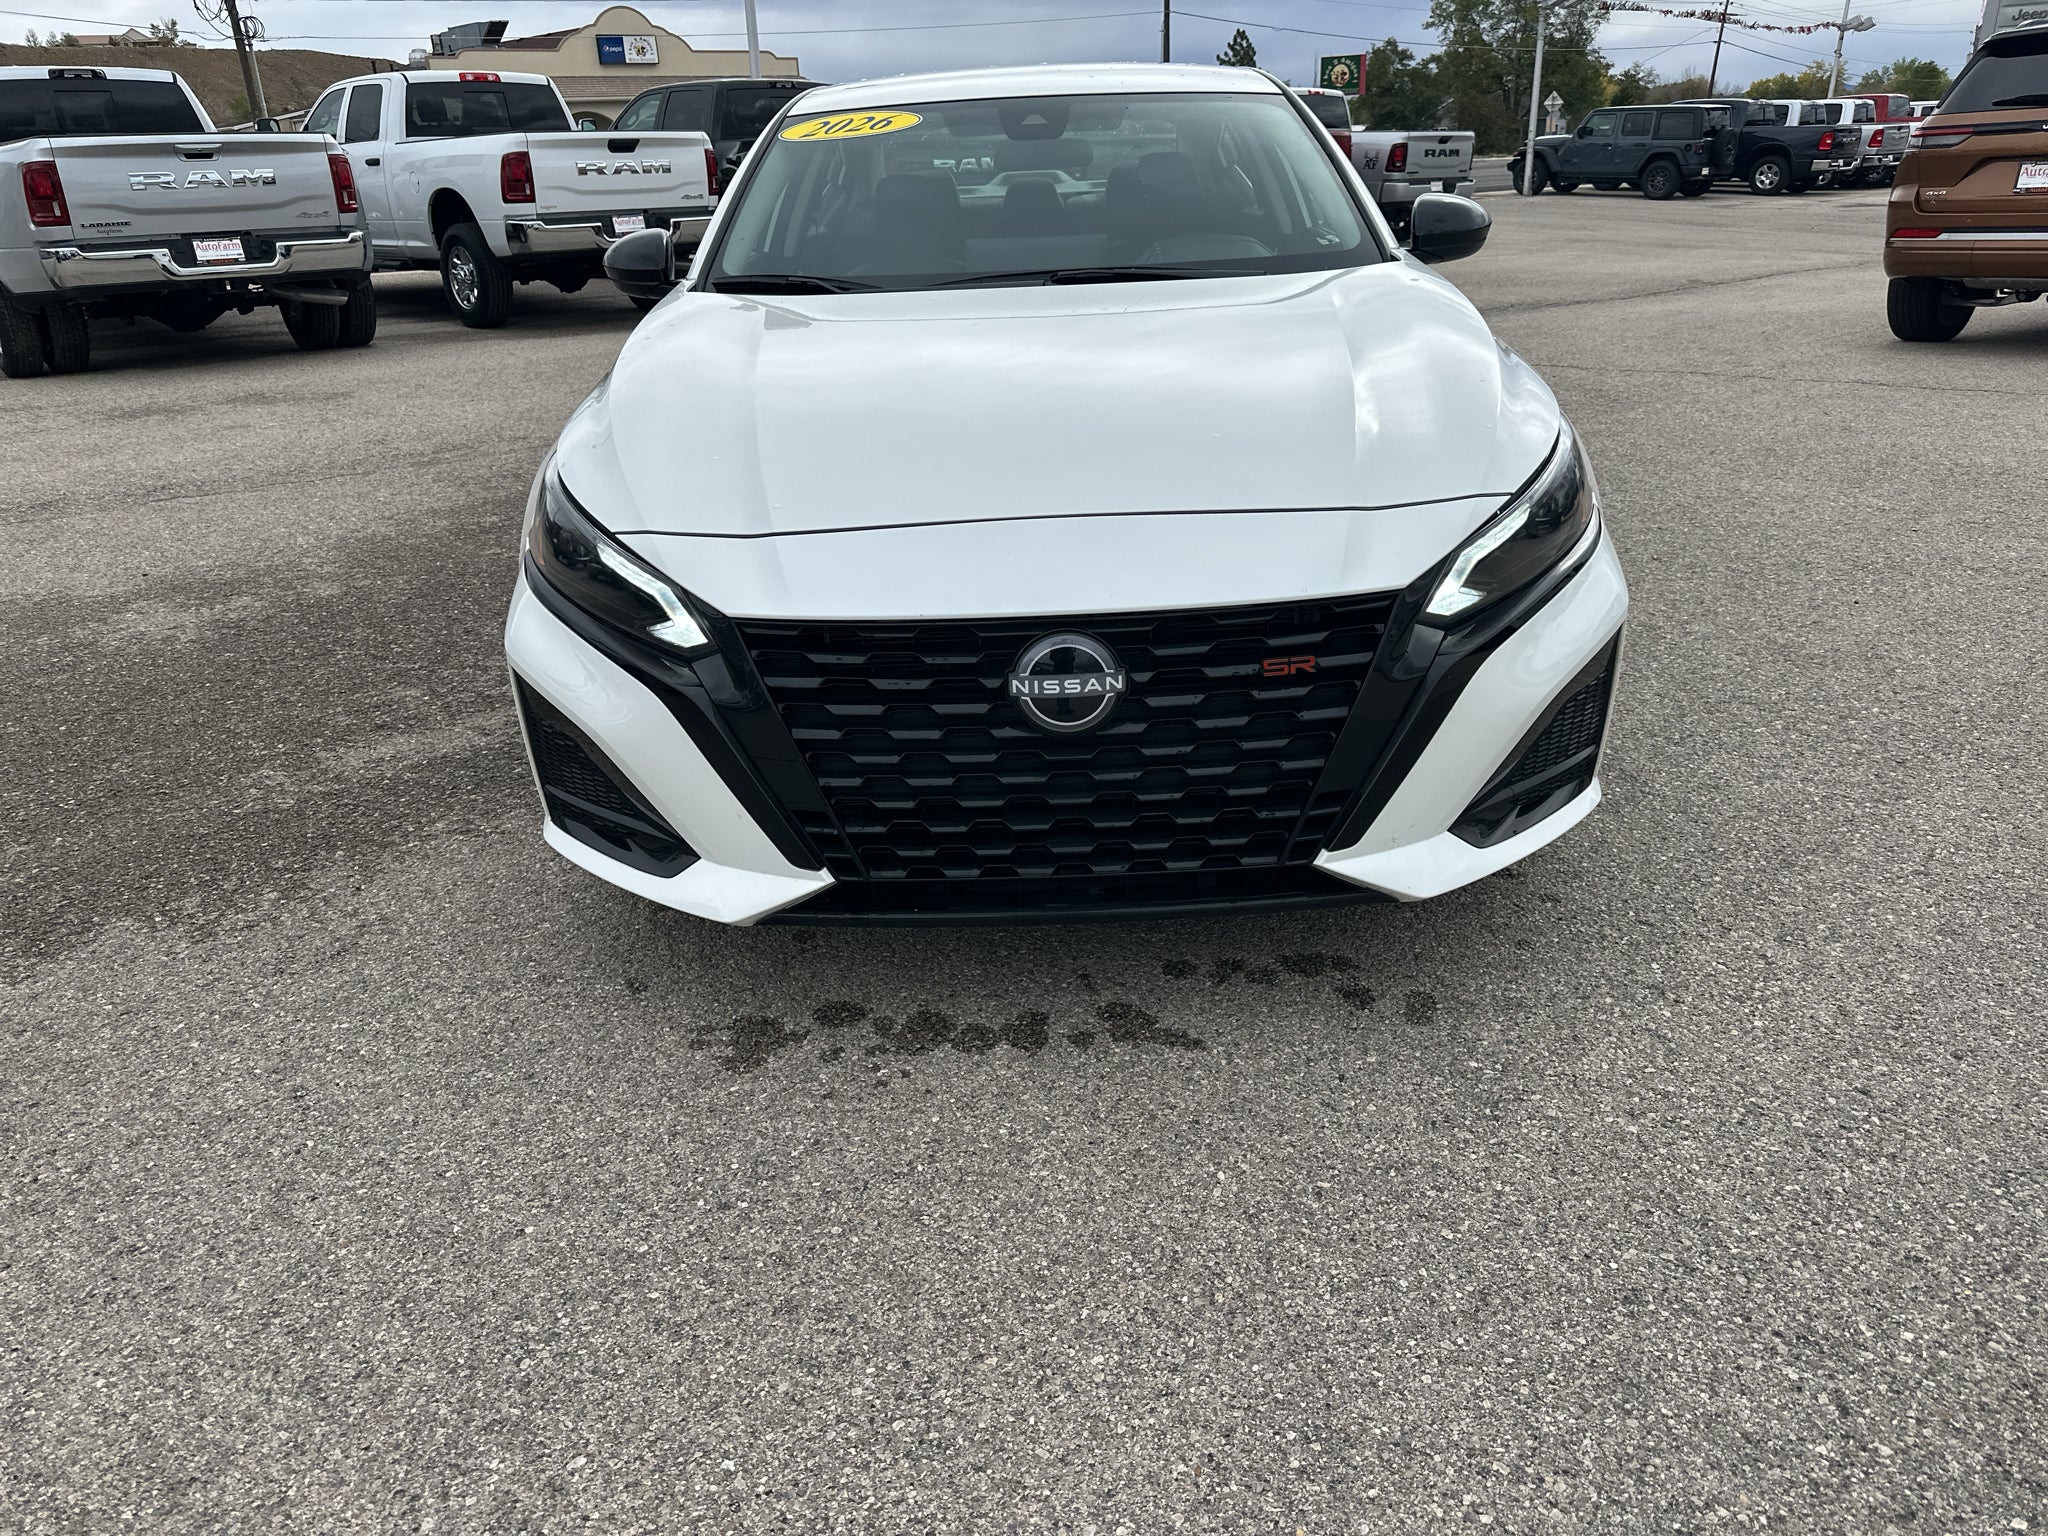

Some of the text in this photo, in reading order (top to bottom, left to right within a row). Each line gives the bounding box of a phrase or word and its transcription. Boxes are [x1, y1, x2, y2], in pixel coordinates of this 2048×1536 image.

[2011, 8, 2048, 21] Jeep
[798, 115, 902, 138] 2026
[1423, 149, 1460, 158] RAM
[575, 159, 672, 176] RAM
[933, 157, 995, 172] RAM
[127, 168, 277, 191] RAM
[195, 242, 241, 251] AutoFarm
[1263, 656, 1317, 677] SR
[1011, 674, 1124, 695] NISSAN
